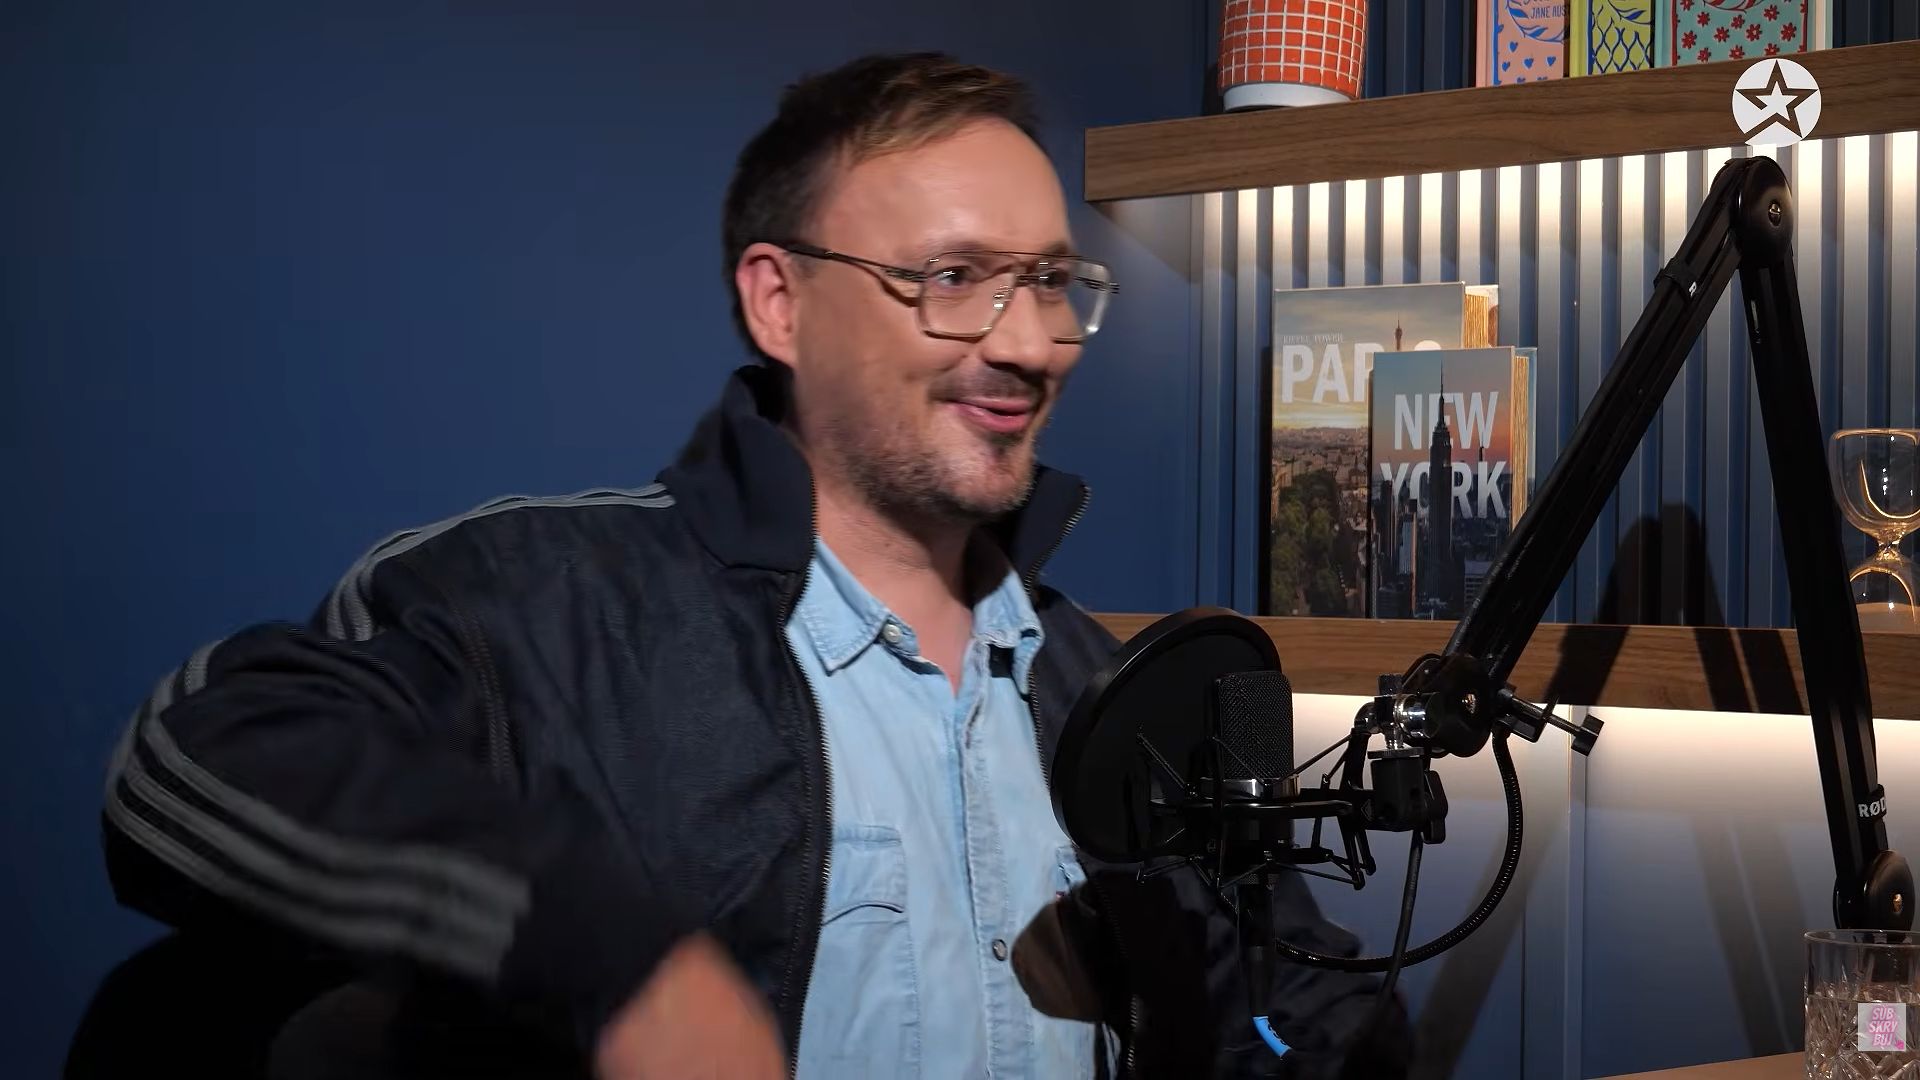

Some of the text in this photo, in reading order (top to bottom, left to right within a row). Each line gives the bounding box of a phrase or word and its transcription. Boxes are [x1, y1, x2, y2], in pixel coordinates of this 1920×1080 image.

[1530, 6, 1550, 19] JANE
[1394, 391, 1500, 451] NEW
[1379, 460, 1508, 519] YORK
